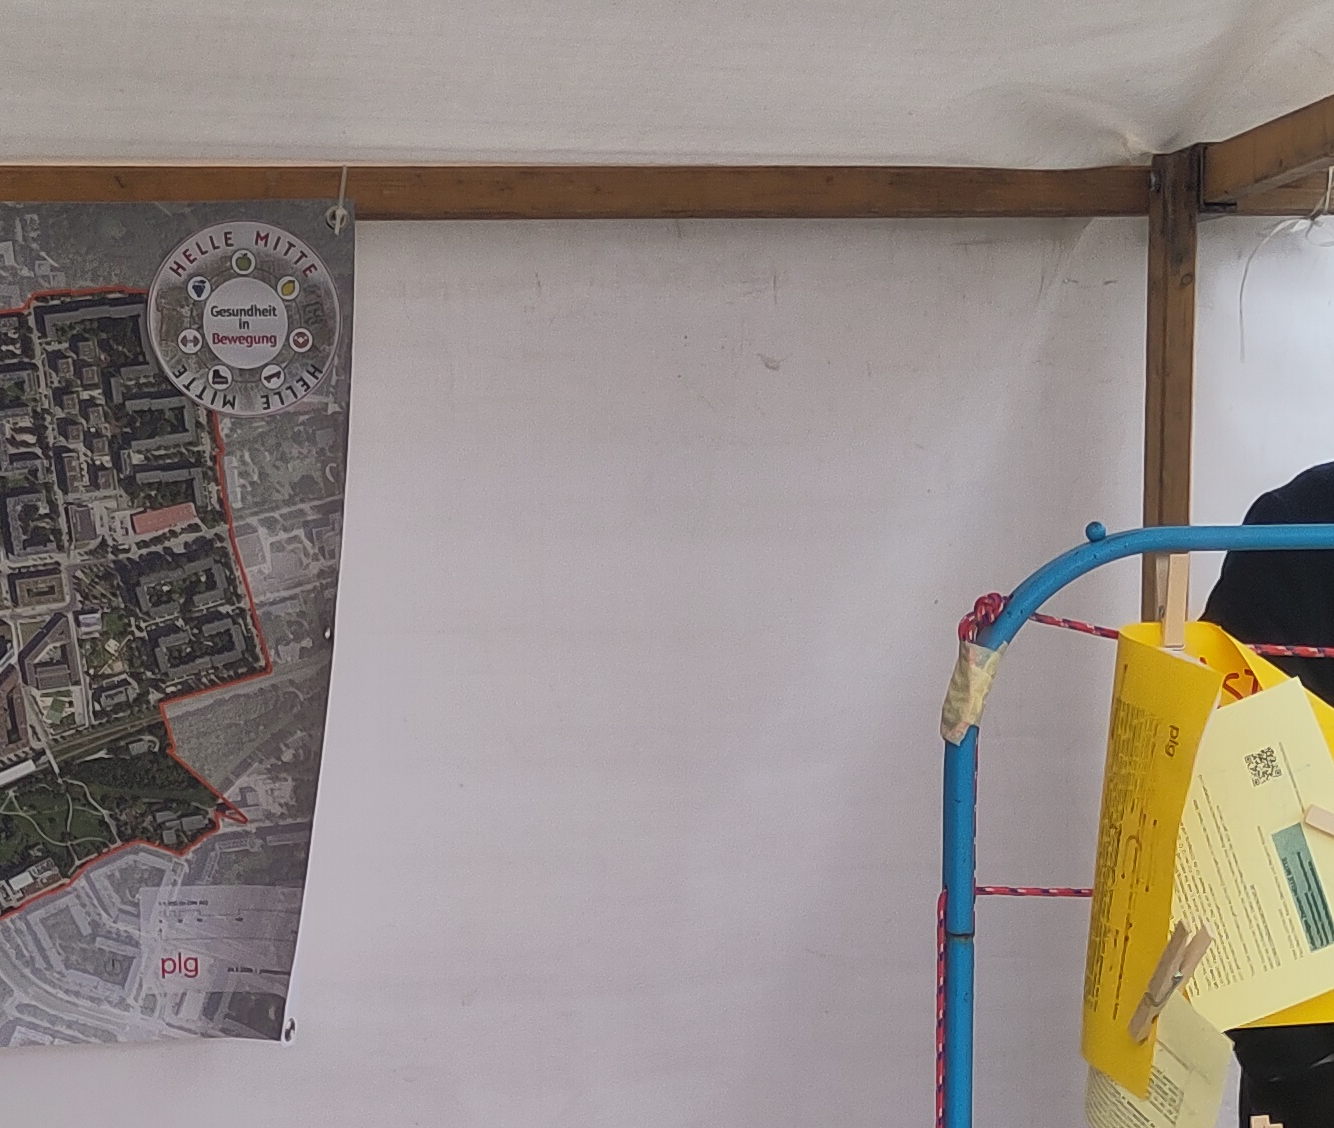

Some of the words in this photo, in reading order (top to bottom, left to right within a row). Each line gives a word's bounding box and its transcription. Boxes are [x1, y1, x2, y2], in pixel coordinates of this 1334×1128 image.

[169, 231, 234, 277] HELLE
[255, 231, 318, 278] MITTE
[210, 304, 278, 318] Gesundheit
[212, 333, 277, 348] Bewegung
[161, 952, 199, 979] plg
